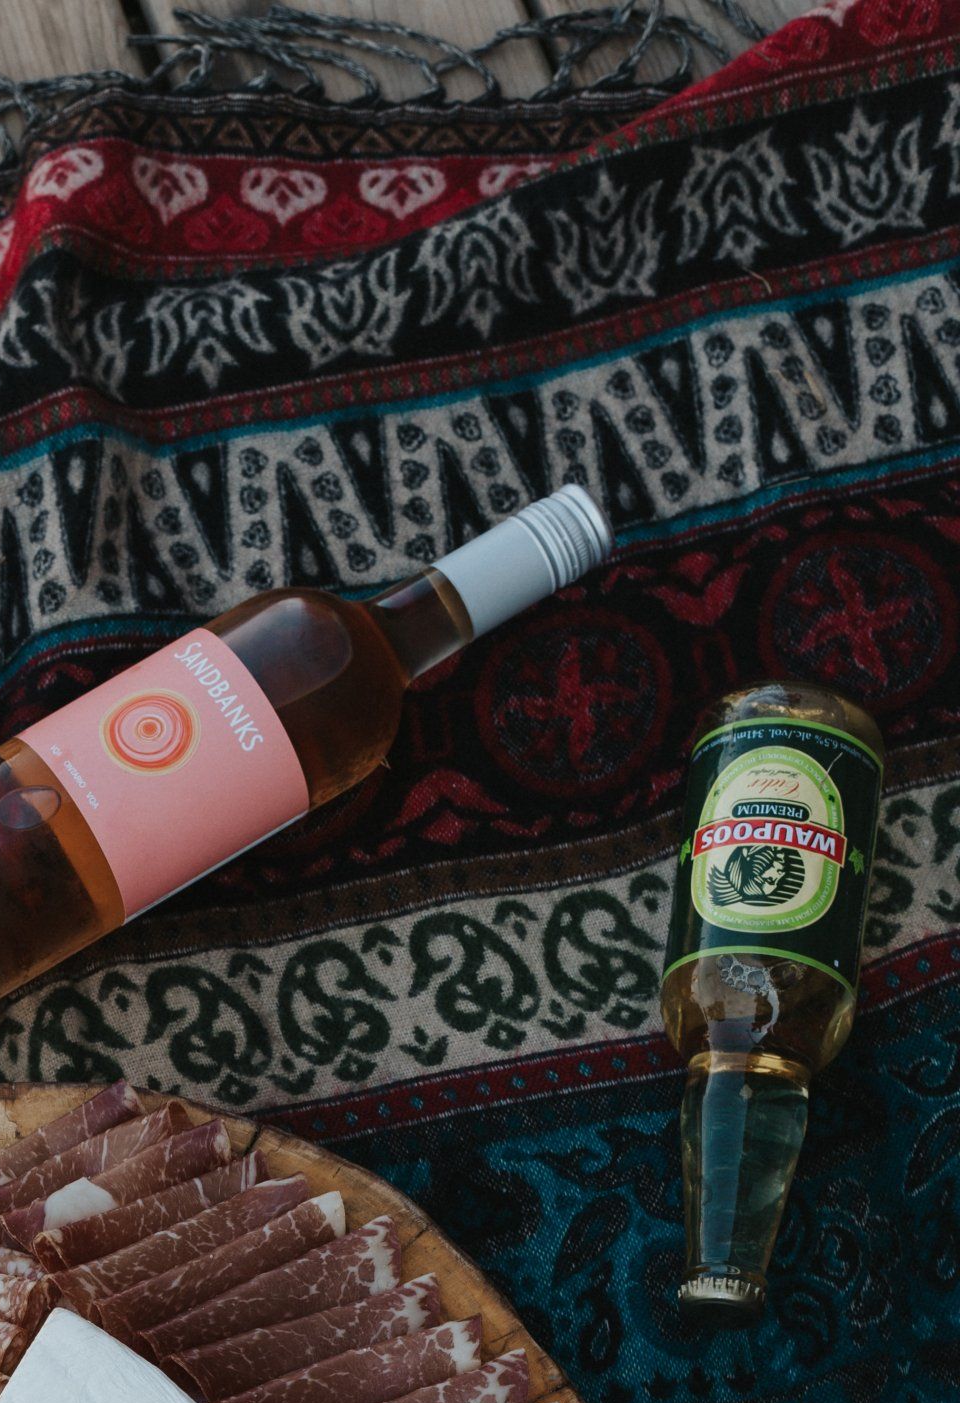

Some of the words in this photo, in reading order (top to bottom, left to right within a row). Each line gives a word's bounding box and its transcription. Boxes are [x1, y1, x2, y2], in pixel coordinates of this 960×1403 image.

[174, 642, 263, 751] SANDBANKS
[814, 735, 838, 750] 6.5%
[746, 778, 800, 798] Cider
[737, 803, 803, 819] PREMIUM
[701, 822, 836, 857] WAUPOOS
